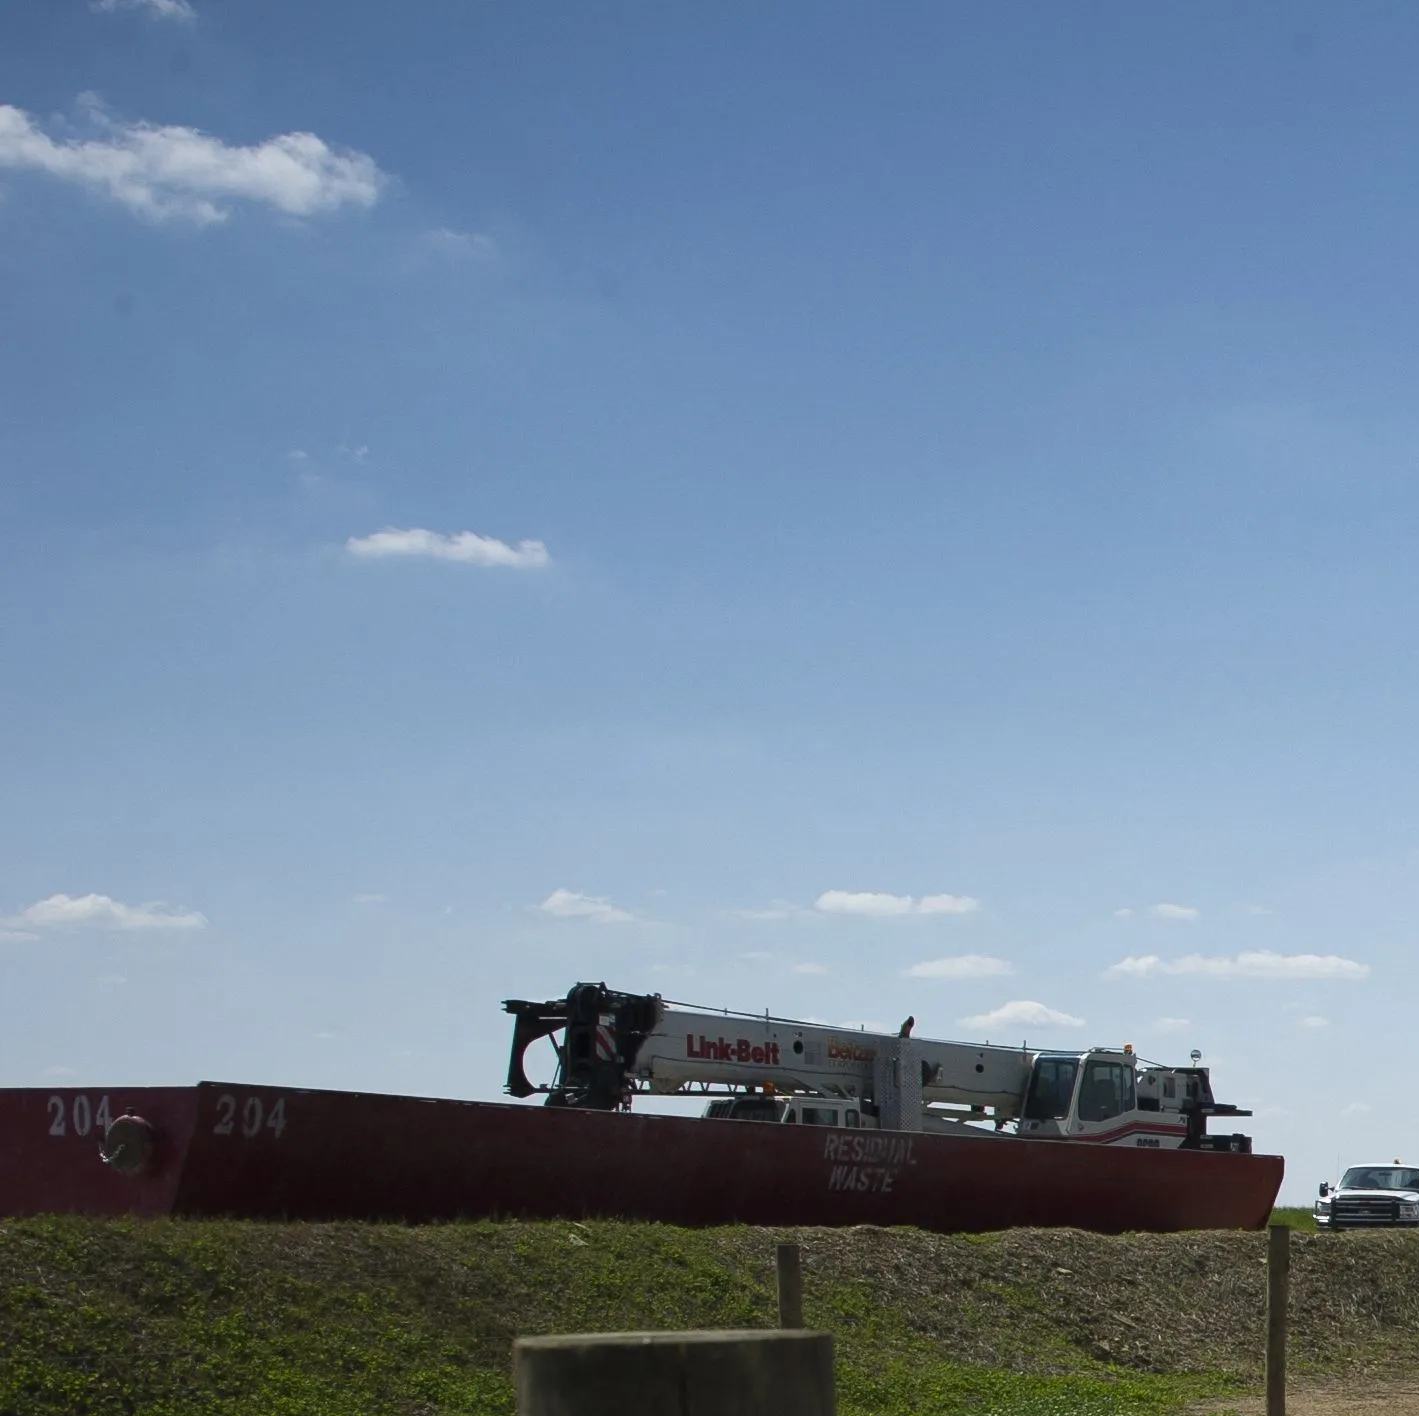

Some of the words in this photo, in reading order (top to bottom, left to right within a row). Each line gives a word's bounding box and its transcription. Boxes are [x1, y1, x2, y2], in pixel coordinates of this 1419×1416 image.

[686, 1033, 781, 1066] Link-Belt
[47, 1094, 113, 1137] 204
[212, 1093, 288, 1139] 204
[823, 1133, 918, 1165] RESIDUAL
[828, 1165, 897, 1192] WASTE
